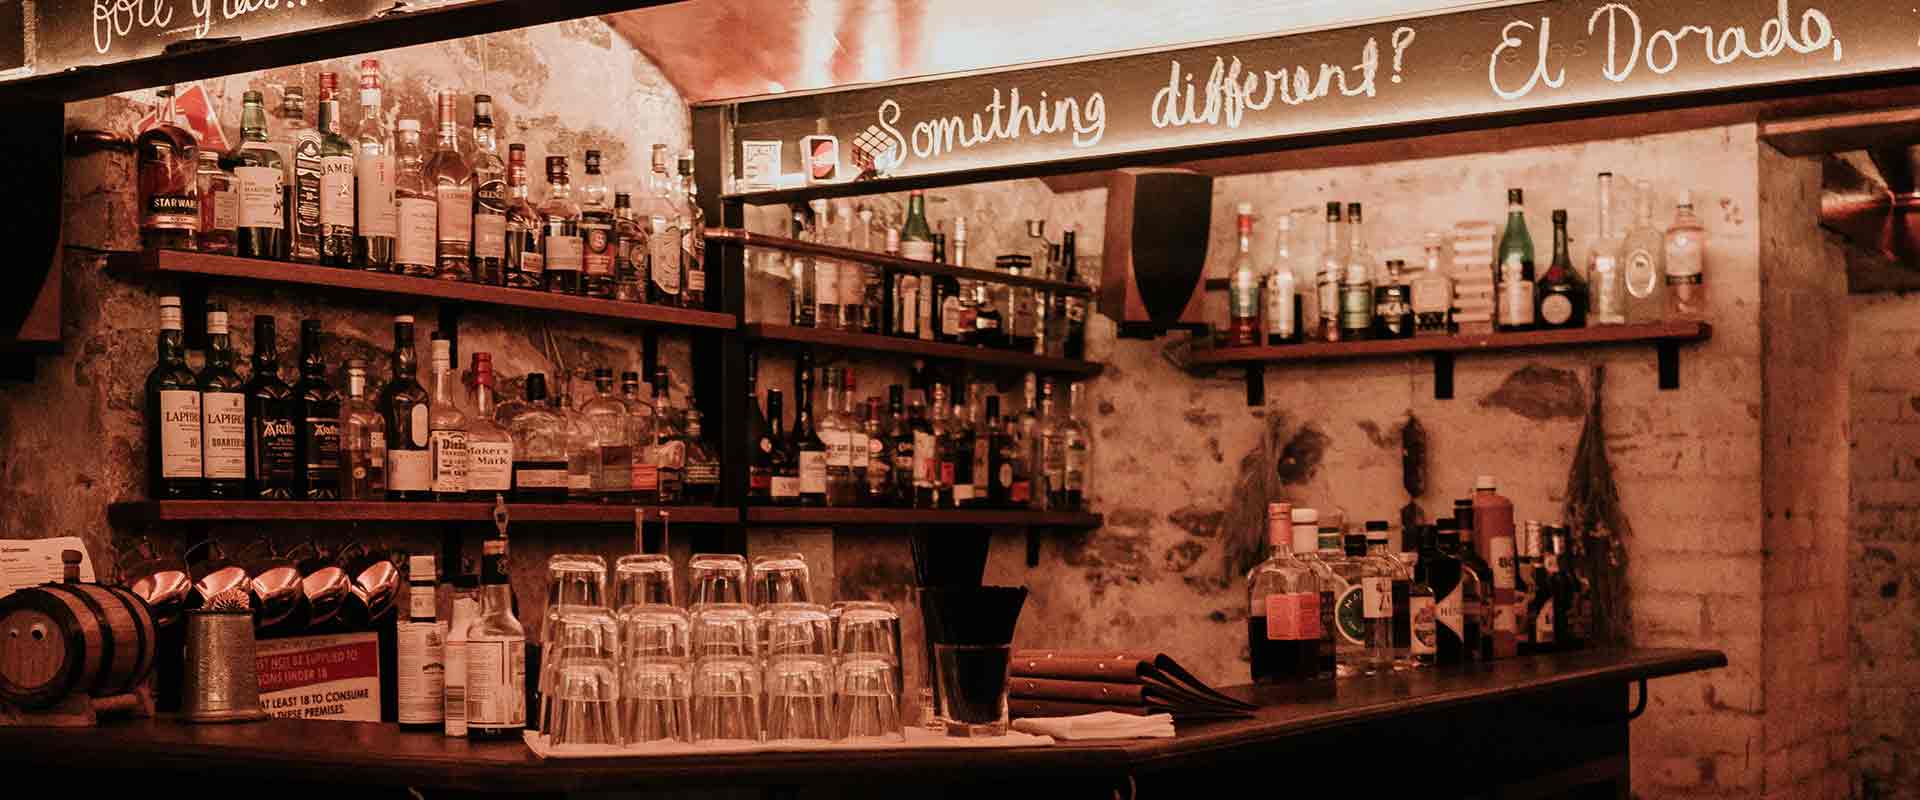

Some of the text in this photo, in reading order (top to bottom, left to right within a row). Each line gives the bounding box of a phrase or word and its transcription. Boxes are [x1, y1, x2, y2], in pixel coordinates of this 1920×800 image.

[877, 87, 1106, 170] Something
[1151, 33, 1416, 128] different?
[1488, 16, 1566, 100] El
[1587, 3, 1842, 81] Dorado,
[272, 696, 297, 709] LEAST
[300, 695, 310, 706] 18
[312, 694, 323, 704] TO
[325, 689, 369, 702] CONSUME
[304, 704, 345, 718] PREMISES
